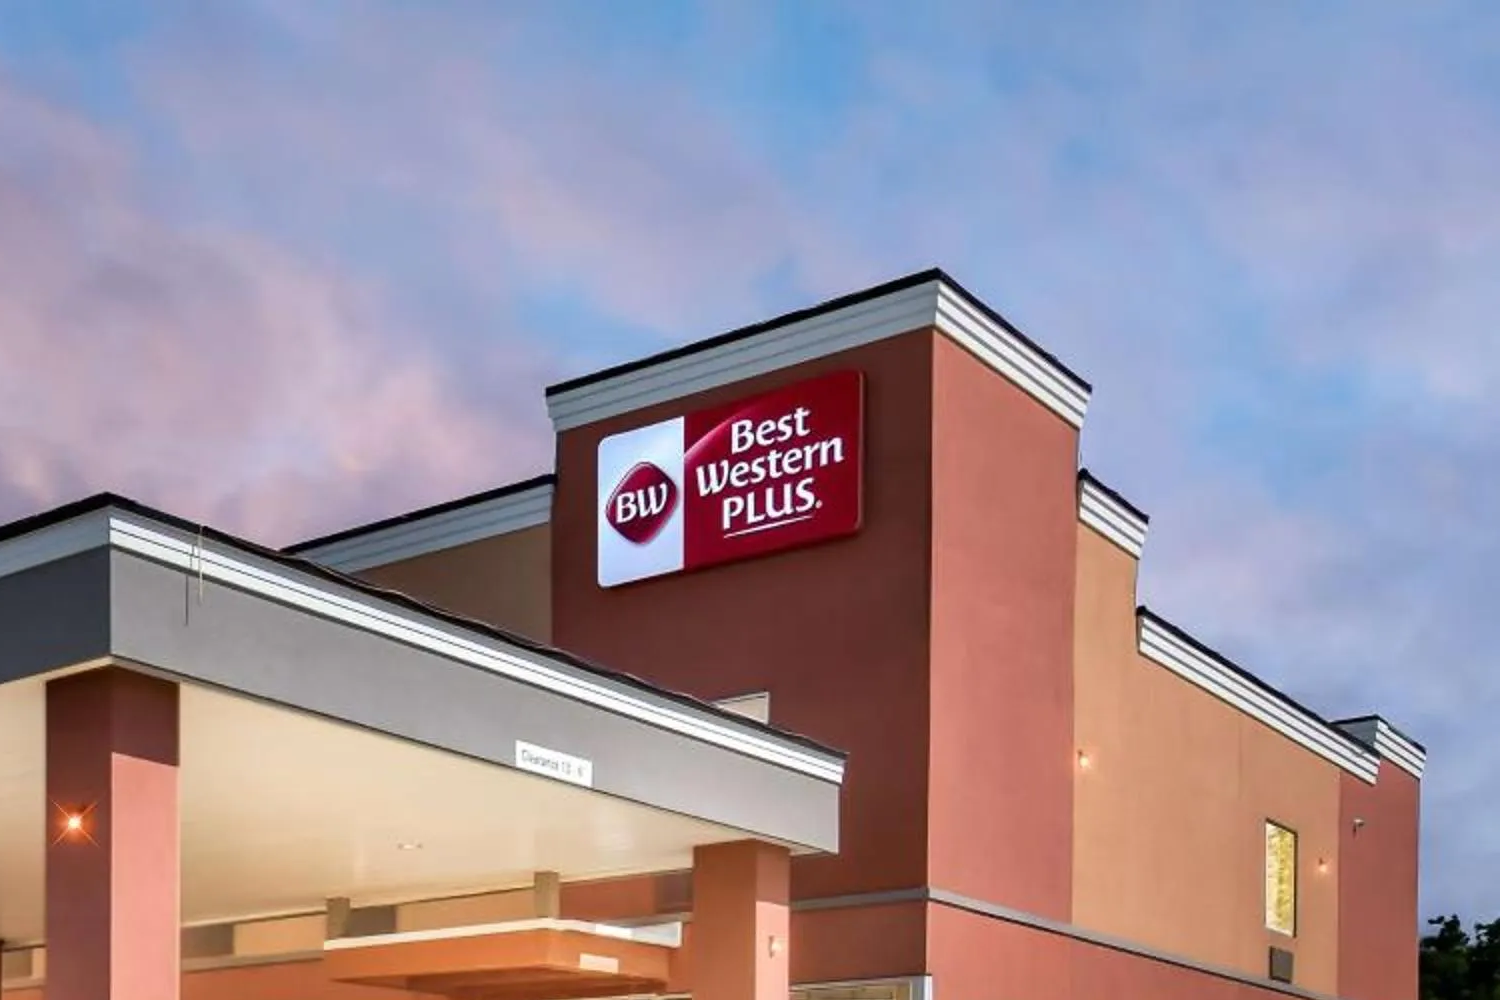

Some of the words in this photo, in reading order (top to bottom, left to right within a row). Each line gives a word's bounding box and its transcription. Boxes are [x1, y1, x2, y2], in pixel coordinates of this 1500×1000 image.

[730, 407, 811, 455] Best
[696, 437, 844, 497] Western
[616, 483, 668, 524] BW
